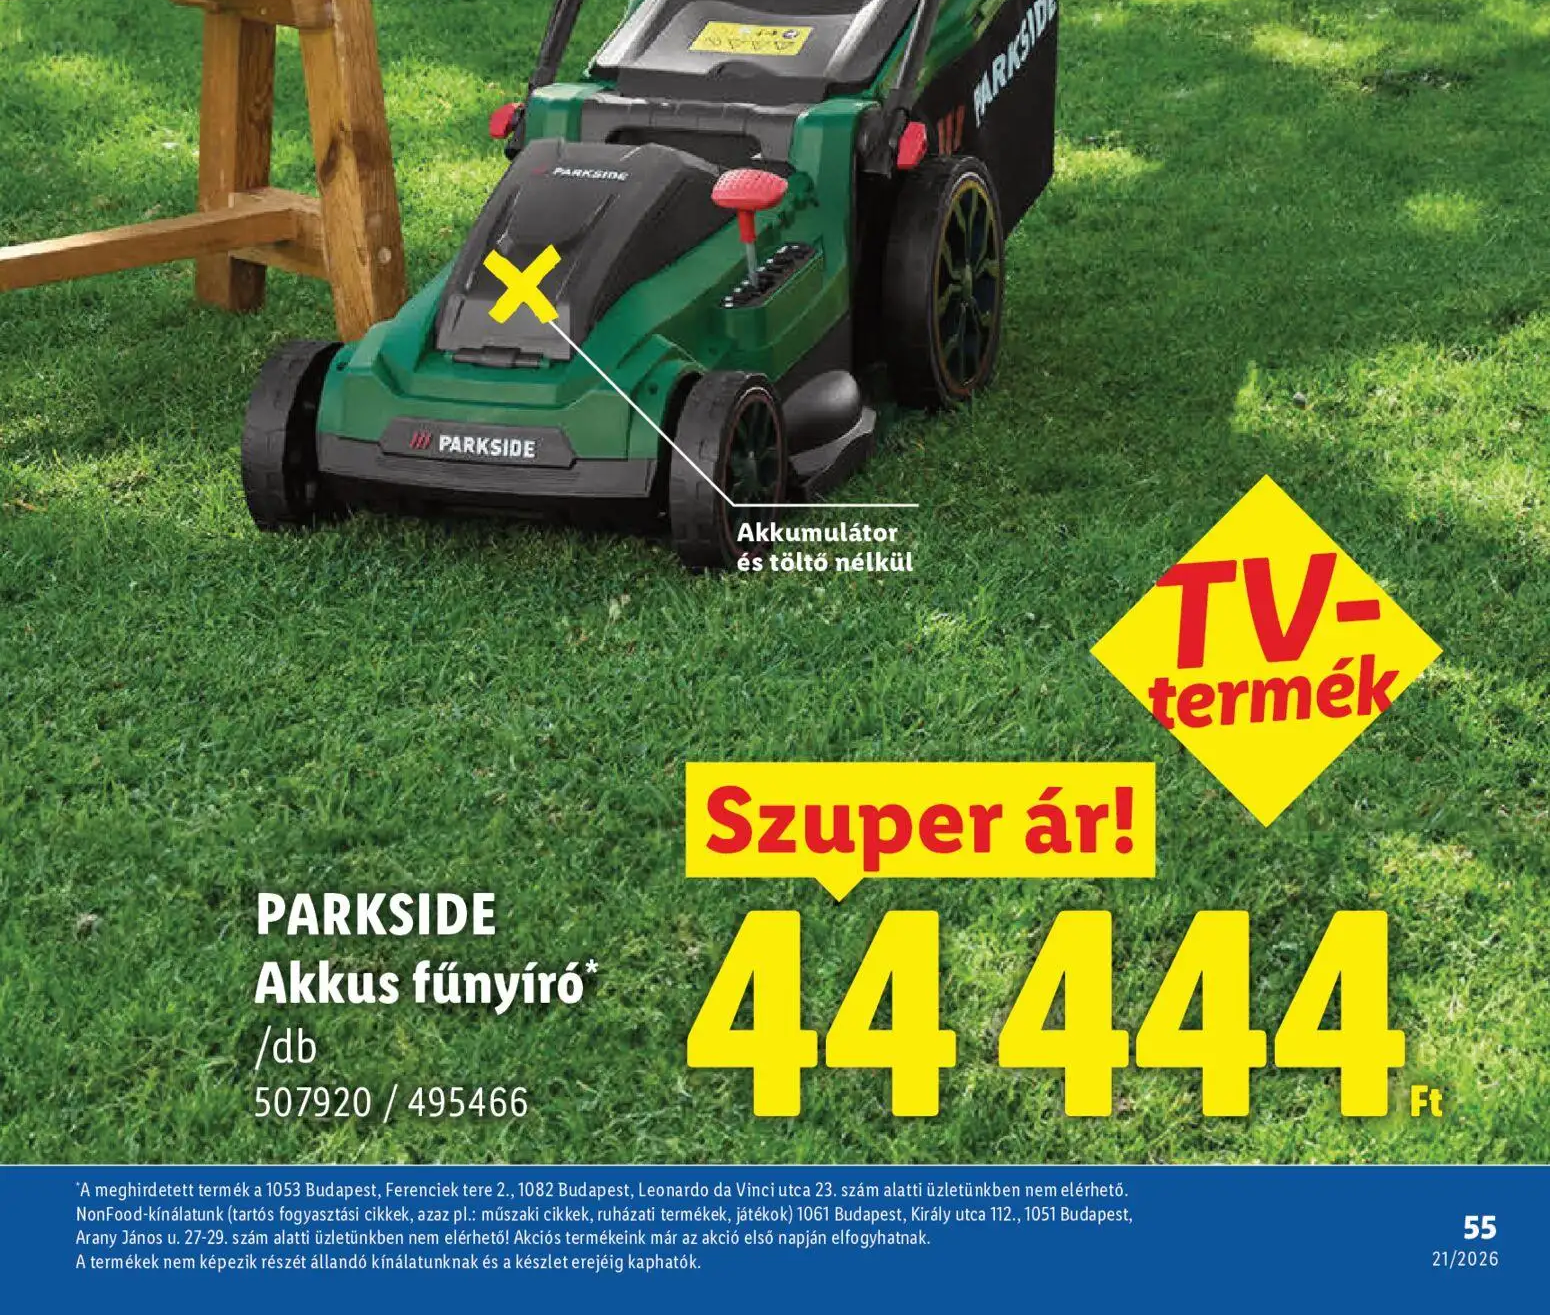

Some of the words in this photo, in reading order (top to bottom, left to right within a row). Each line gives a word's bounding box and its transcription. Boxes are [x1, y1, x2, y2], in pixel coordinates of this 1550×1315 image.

[553, 166, 629, 181] PARKSIDE
[440, 434, 536, 458] PARKSIDE
[737, 522, 898, 542] Akkumulátor
[737, 553, 763, 572] és
[769, 552, 829, 572] töltő
[835, 552, 914, 572] nélkül
[1156, 552, 1381, 670] TV-
[1148, 654, 1400, 730] termék
[706, 785, 1003, 872] Szuper
[1025, 786, 1134, 854] ár!
[257, 892, 496, 936] PARKSIDE
[254, 960, 400, 1004] Akkus
[687, 910, 957, 1117] 44
[999, 910, 1406, 1117] 444
[1411, 1085, 1443, 1117] Ft
[254, 1025, 317, 1071] /db
[254, 1086, 372, 1118] 507920
[384, 1084, 398, 1123] /
[408, 1086, 528, 1118] 495466
[95, 1181, 194, 1201] meghirdetett
[198, 1182, 250, 1197] termék
[254, 1185, 263, 1197] a
[266, 1181, 301, 1197] 1053
[305, 1181, 382, 1201] Budapest,
[386, 1182, 459, 1197] Ferenciek
[462, 1184, 493, 1197] tere
[497, 1181, 515, 1199] 2.,
[518, 1181, 554, 1197] 1082
[558, 1181, 634, 1200] Budapest,
[639, 1182, 709, 1197] Leonardo
[713, 1181, 732, 1197] da
[736, 1182, 775, 1197] Vinci
[778, 1183, 811, 1197] utca
[815, 1181, 837, 1197] 23.
[841, 1182, 879, 1197] szám
[883, 1181, 922, 1197] alatti
[927, 1182, 1020, 1197] üzletünkben
[1025, 1185, 1057, 1197] nem
[1060, 1181, 1128, 1197] elérhető.
[76, 1206, 224, 1222] NonFood-kínálatunk
[228, 1205, 274, 1224] (tartós
[279, 1205, 359, 1226] fogyasztási
[364, 1206, 414, 1223] cikkek,
[417, 1210, 449, 1222] azaz
[453, 1206, 476, 1225] pl.:
[481, 1206, 539, 1222] műszaki
[543, 1206, 594, 1224] cikkek,
[597, 1206, 655, 1222] ruházati
[660, 1206, 731, 1223] termékek,
[736, 1204, 793, 1225] játékok)
[797, 1206, 829, 1222] 1061
[835, 1206, 907, 1225] Budapest,
[911, 1206, 951, 1225] Király
[955, 1208, 986, 1222] utca
[990, 1206, 1021, 1223] 112.,
[1024, 1206, 1055, 1222] 1051
[1060, 1206, 1133, 1225] Budapest,
[75, 1229, 117, 1249] Arany
[122, 1229, 163, 1245] János
[167, 1233, 180, 1245] u.
[184, 1229, 228, 1245] 27-29.
[232, 1230, 268, 1245] szám
[273, 1229, 310, 1245] alatti
[315, 1229, 404, 1245] üzletünkben
[408, 1233, 439, 1245] nem
[444, 1229, 509, 1245] elérhető!
[513, 1229, 561, 1245] Akciós
[565, 1229, 646, 1245] termékeink
[650, 1229, 678, 1245] már
[682, 1233, 698, 1245] az
[702, 1229, 739, 1245] akció
[744, 1229, 774, 1245] első
[778, 1229, 827, 1249] napján
[831, 1229, 930, 1249] elfogyhatnak.
[1463, 1215, 1497, 1240] 55
[75, 1253, 86, 1269] A
[90, 1253, 159, 1269] termékek
[163, 1257, 195, 1269] nem
[200, 1253, 257, 1273] képezik
[261, 1254, 307, 1269] részét
[310, 1253, 367, 1269] állandó
[372, 1253, 479, 1269] kínálatunknak
[482, 1254, 498, 1269] és
[503, 1257, 511, 1269] a
[515, 1254, 569, 1269] készlet
[571, 1254, 624, 1273] erejéig
[628, 1253, 701, 1273] kaphatók.
[1432, 1249, 1499, 1269] 21/2026
